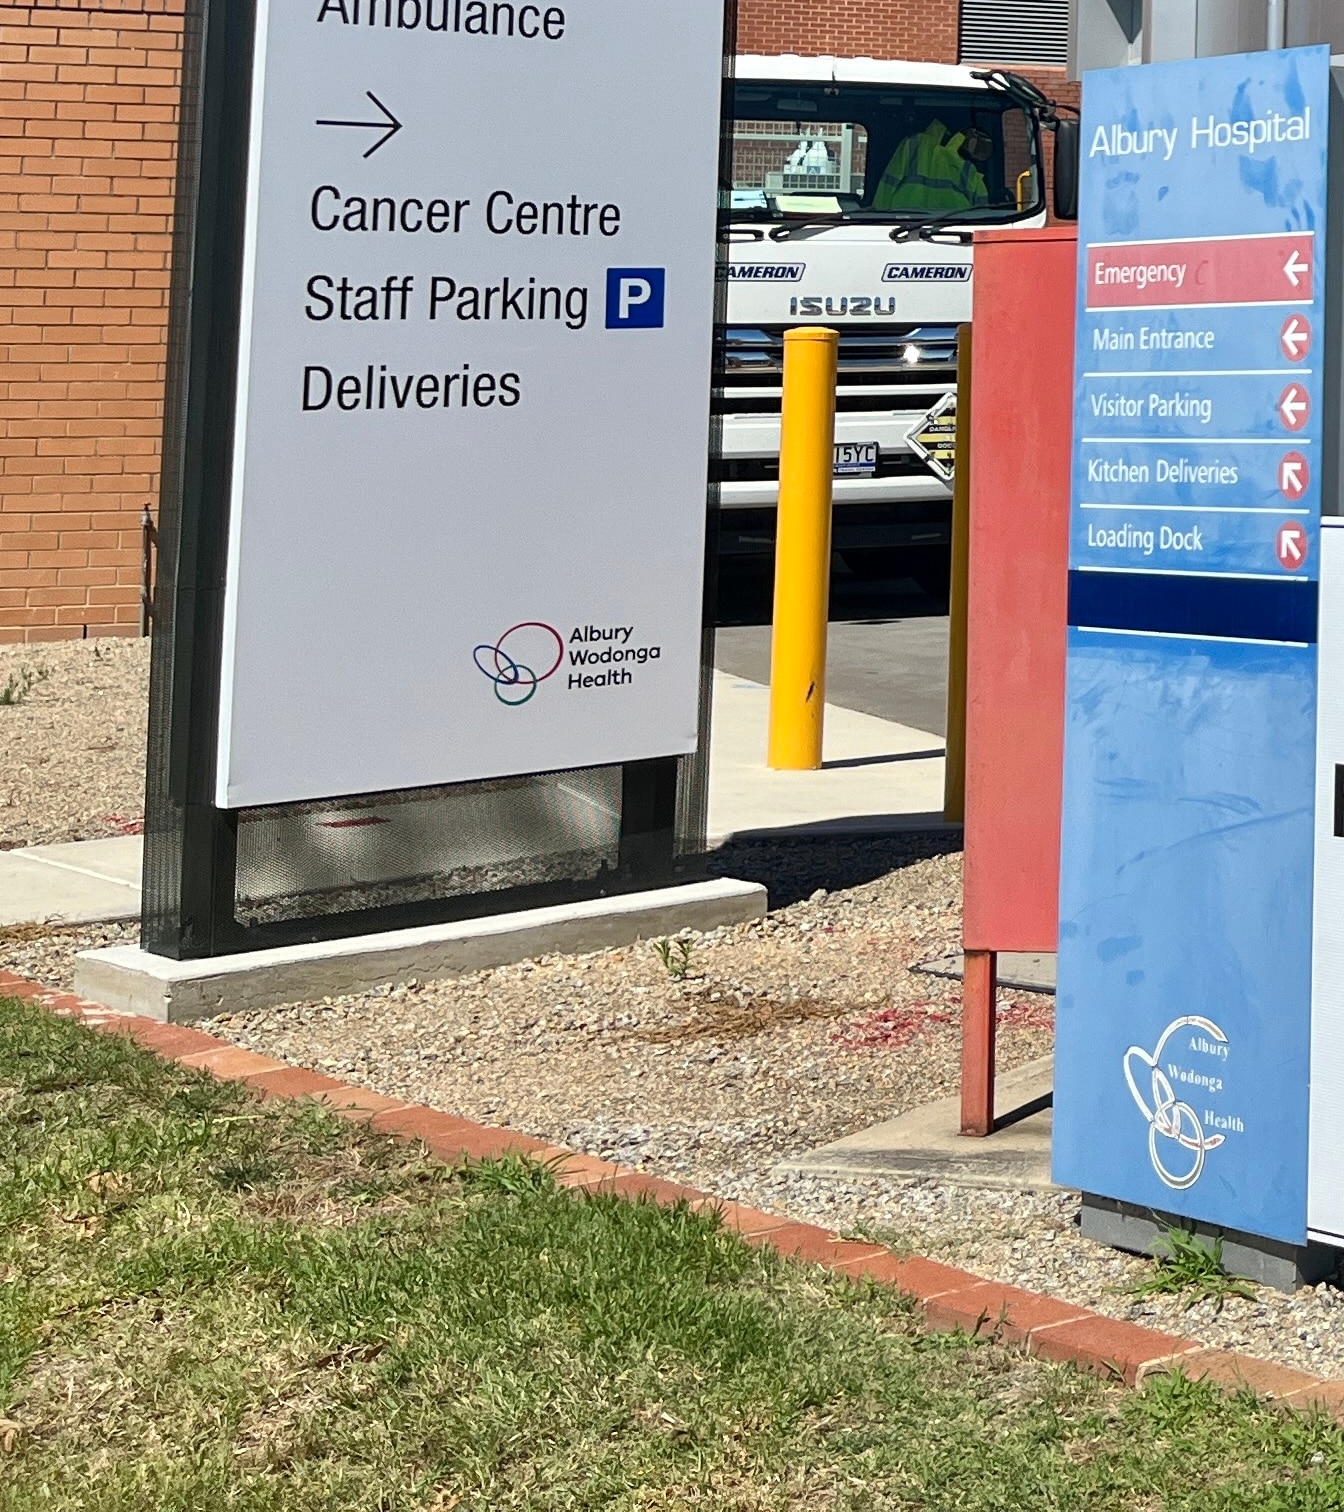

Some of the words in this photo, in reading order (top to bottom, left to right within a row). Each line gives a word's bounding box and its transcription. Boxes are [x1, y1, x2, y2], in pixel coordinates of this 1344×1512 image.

[1089, 124, 1178, 161] Albury
[1191, 107, 1311, 153] Hospital
[311, 185, 470, 233] Cancer
[486, 190, 621, 236] Centre
[887, 266, 967, 278] CAMERON
[1095, 262, 1187, 289] Emergency
[305, 274, 413, 320] Staff
[429, 276, 588, 330] Parking
[618, 278, 651, 319] P
[790, 296, 896, 316] ISUZU
[1093, 327, 1134, 350] Main
[1140, 326, 1215, 350] Entrance
[302, 364, 521, 411] Deliveries
[1091, 393, 1143, 417] Visitor
[1149, 392, 1212, 424] Parking
[1088, 458, 1149, 483] Kitchen
[1156, 459, 1239, 484] Deliveries
[1088, 524, 1154, 555] Loading
[1159, 525, 1203, 551] Dock
[569, 625, 633, 644] Albury
[569, 646, 661, 666] Wodonga
[568, 668, 632, 689] Health
[1189, 1036, 1229, 1061] Albury
[1167, 1064, 1223, 1092] Wodonga
[1204, 1110, 1245, 1133] Health
